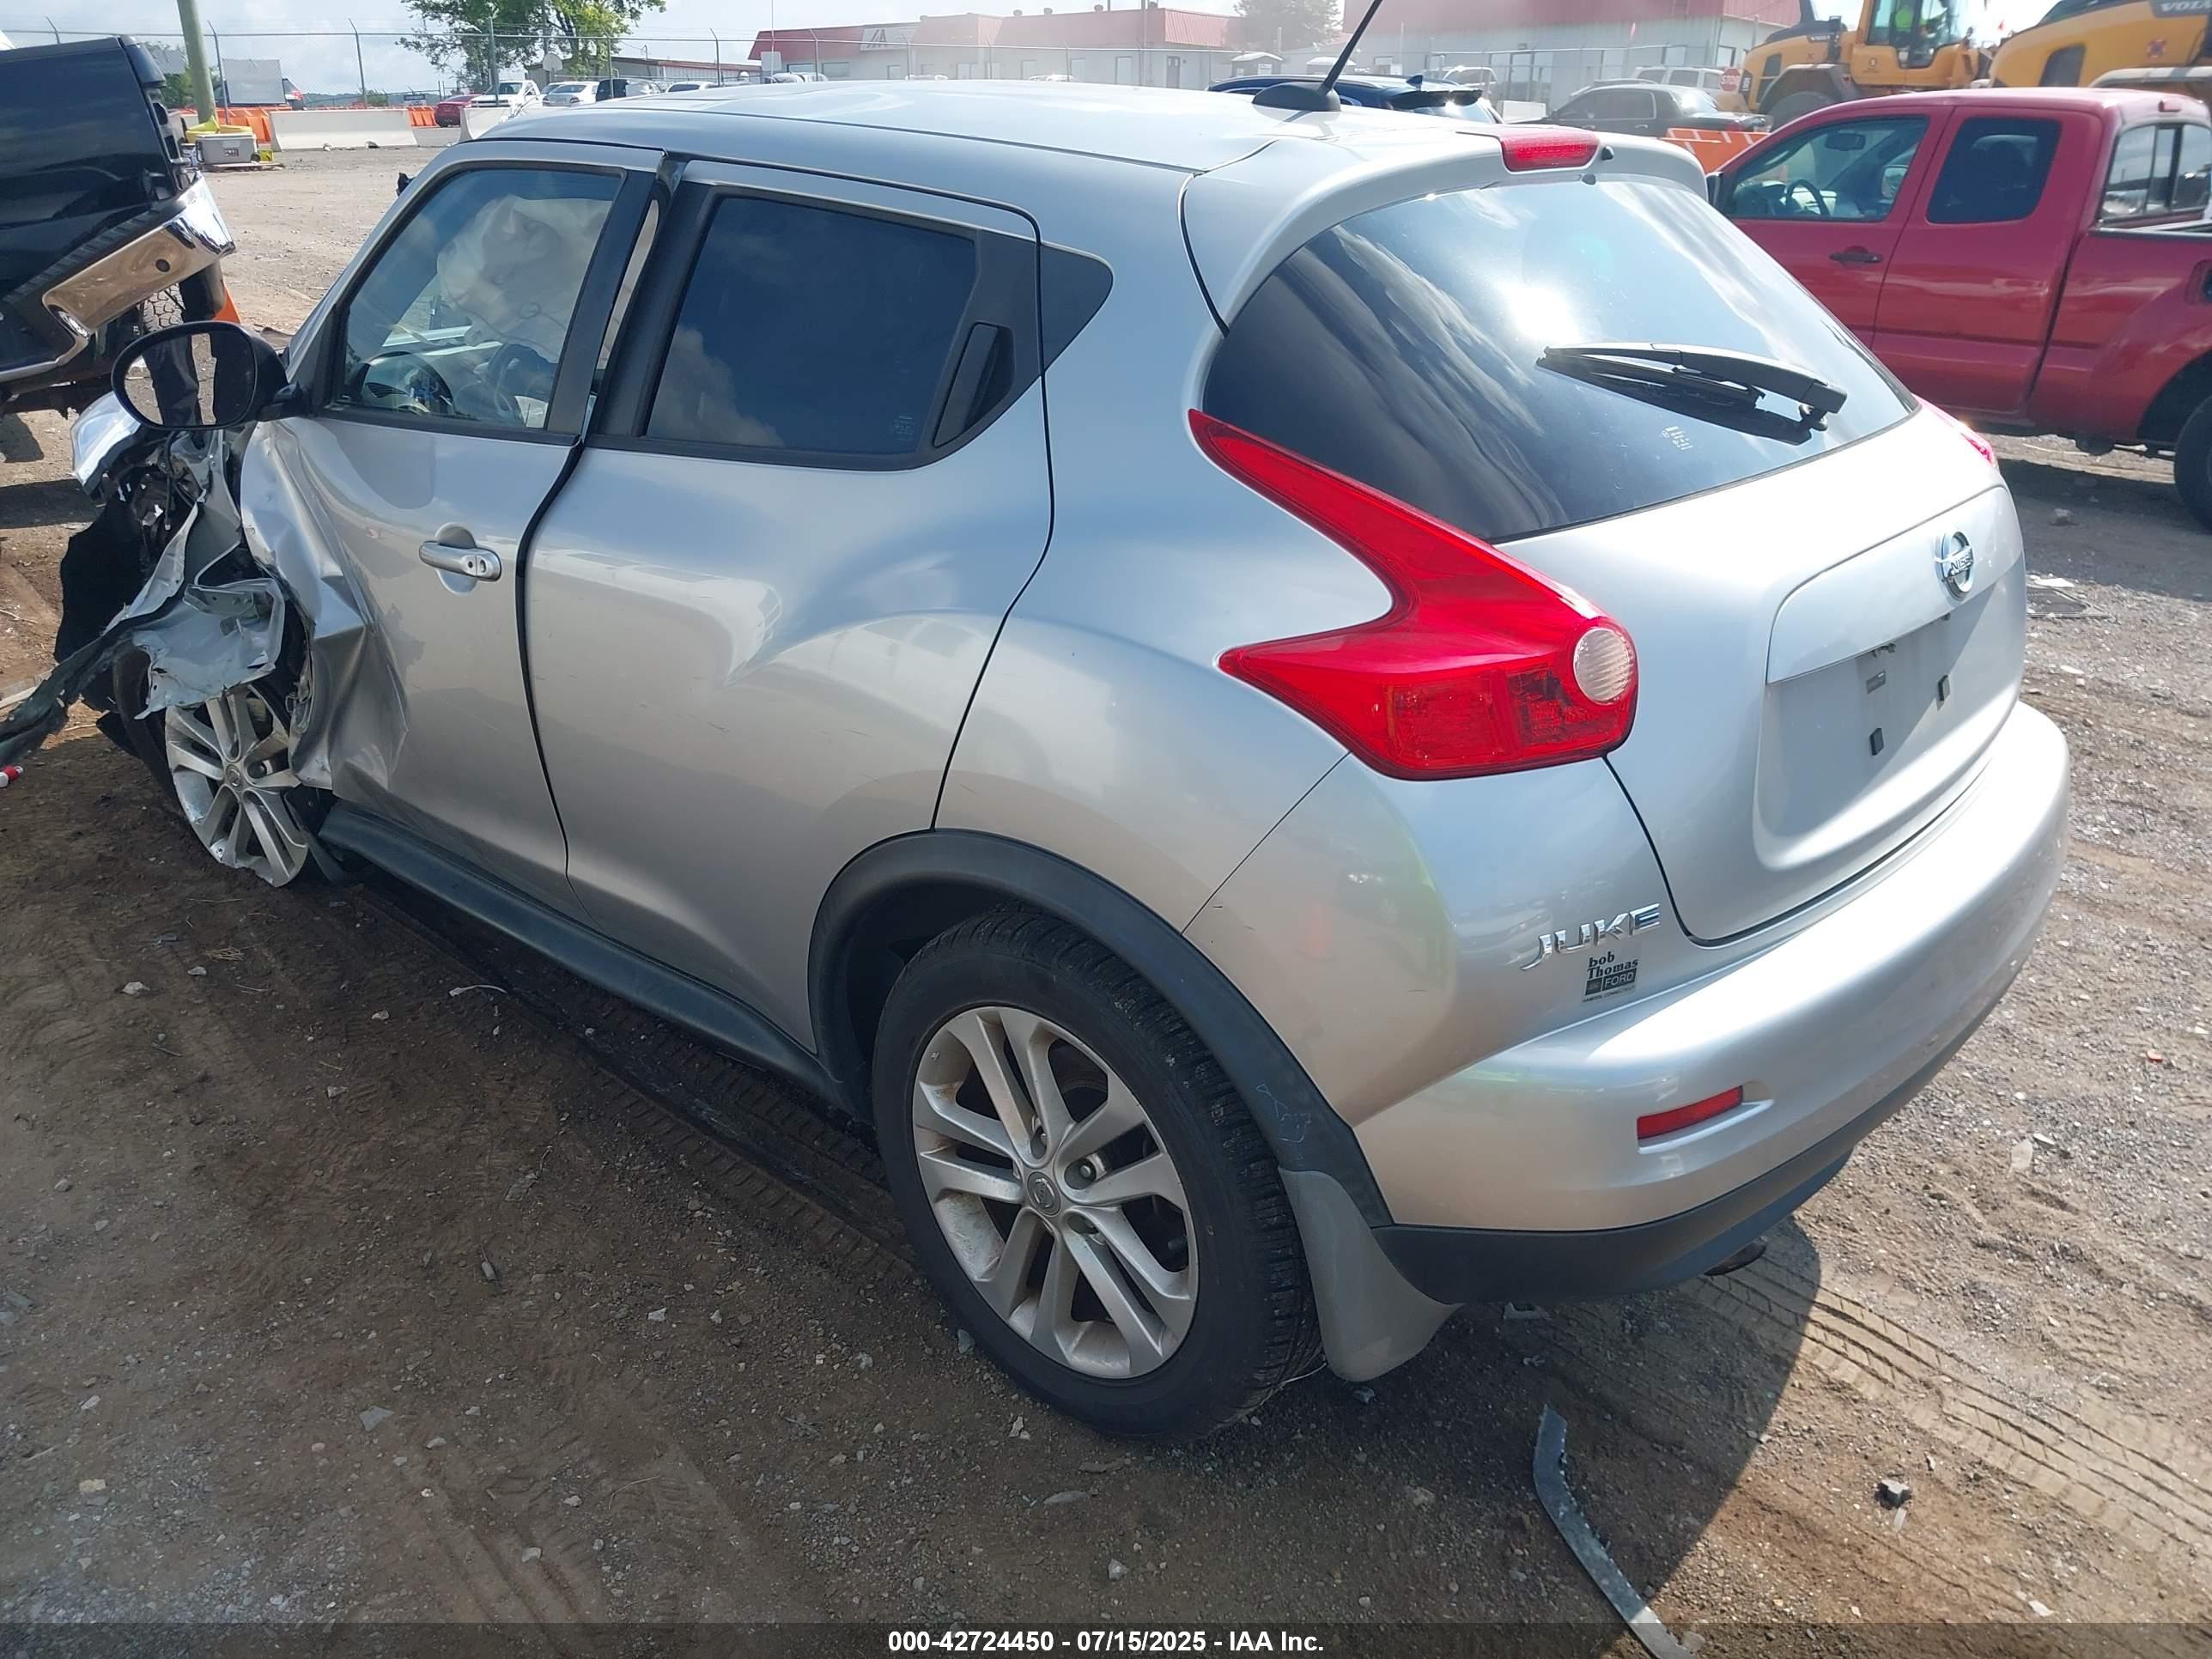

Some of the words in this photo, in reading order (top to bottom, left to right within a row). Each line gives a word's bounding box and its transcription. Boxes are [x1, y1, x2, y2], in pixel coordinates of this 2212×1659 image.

[1520, 902, 1661, 971] JUKE
[1586, 958, 1639, 980] Thomas
[1588, 951, 1615, 968] bob
[1604, 971, 1634, 988] FORD
